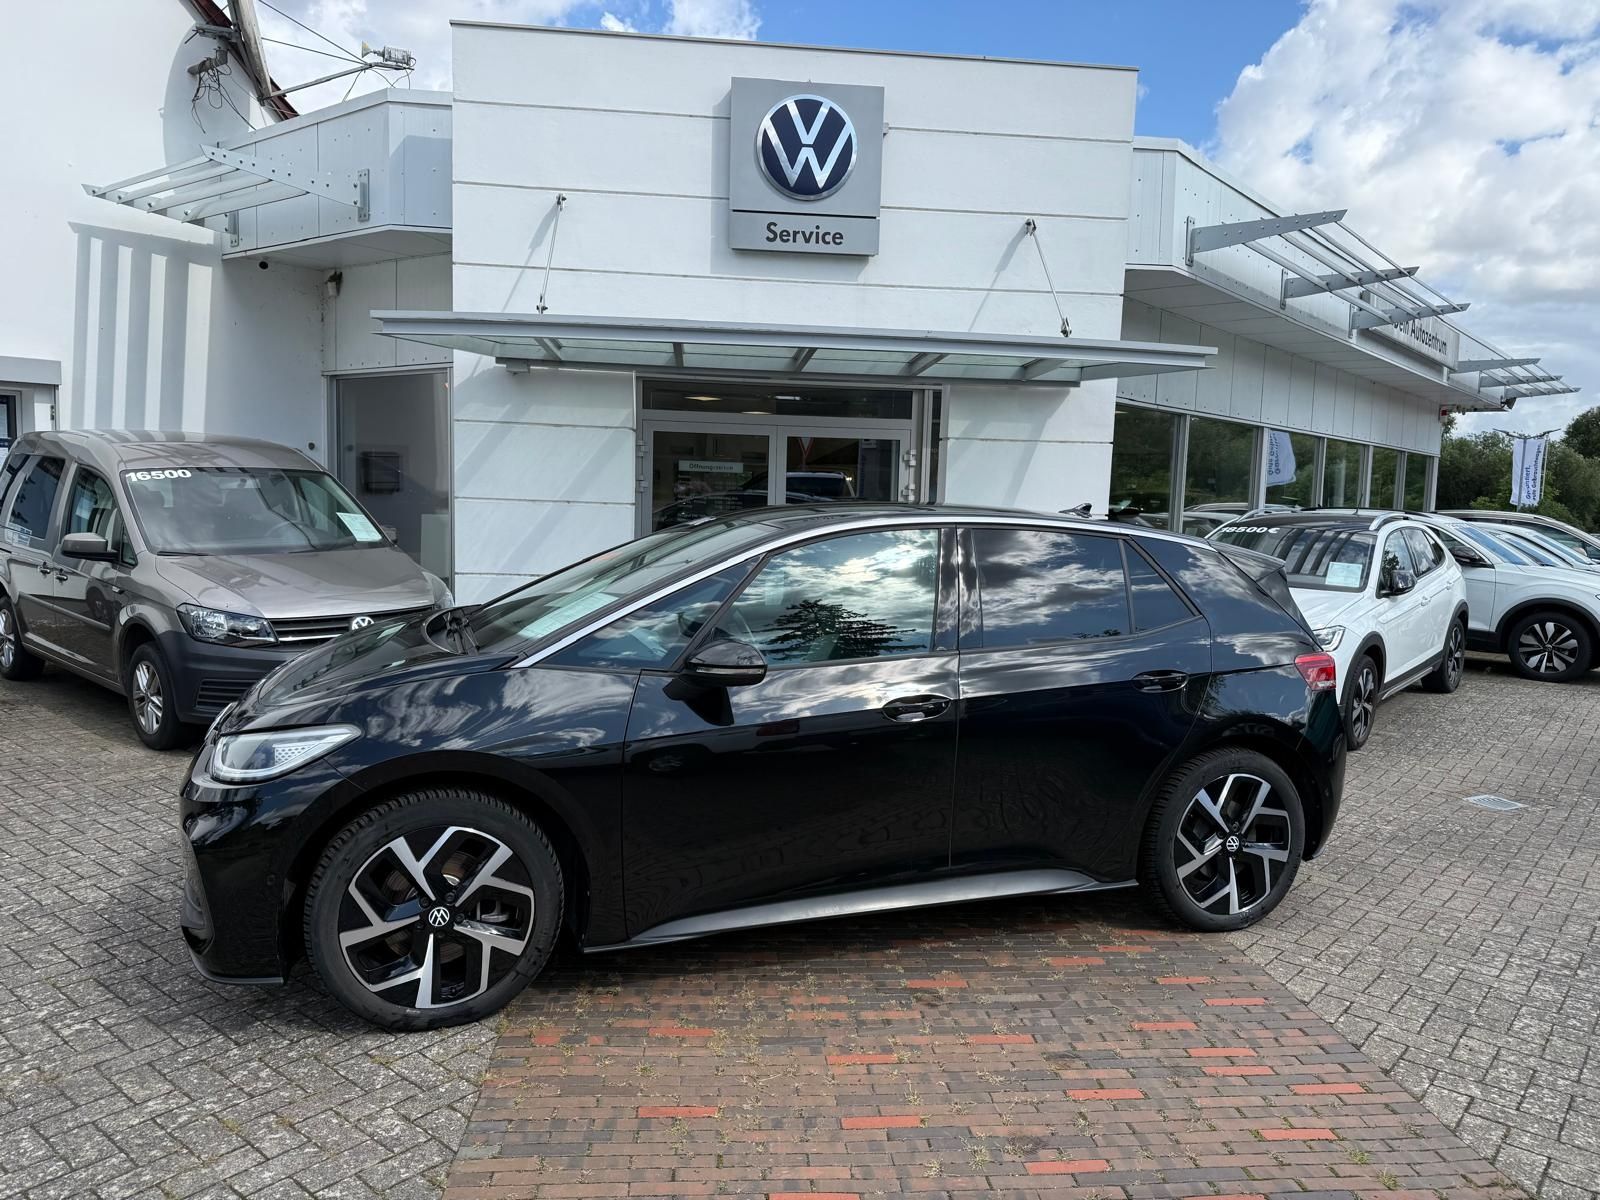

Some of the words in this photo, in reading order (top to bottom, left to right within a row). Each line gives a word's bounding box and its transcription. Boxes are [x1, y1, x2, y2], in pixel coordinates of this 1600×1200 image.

[760, 97, 854, 194] VW
[766, 222, 843, 245] Service
[1411, 320, 1447, 355] Autozentrum
[126, 469, 192, 481] 16500
[429, 907, 450, 926] VW
